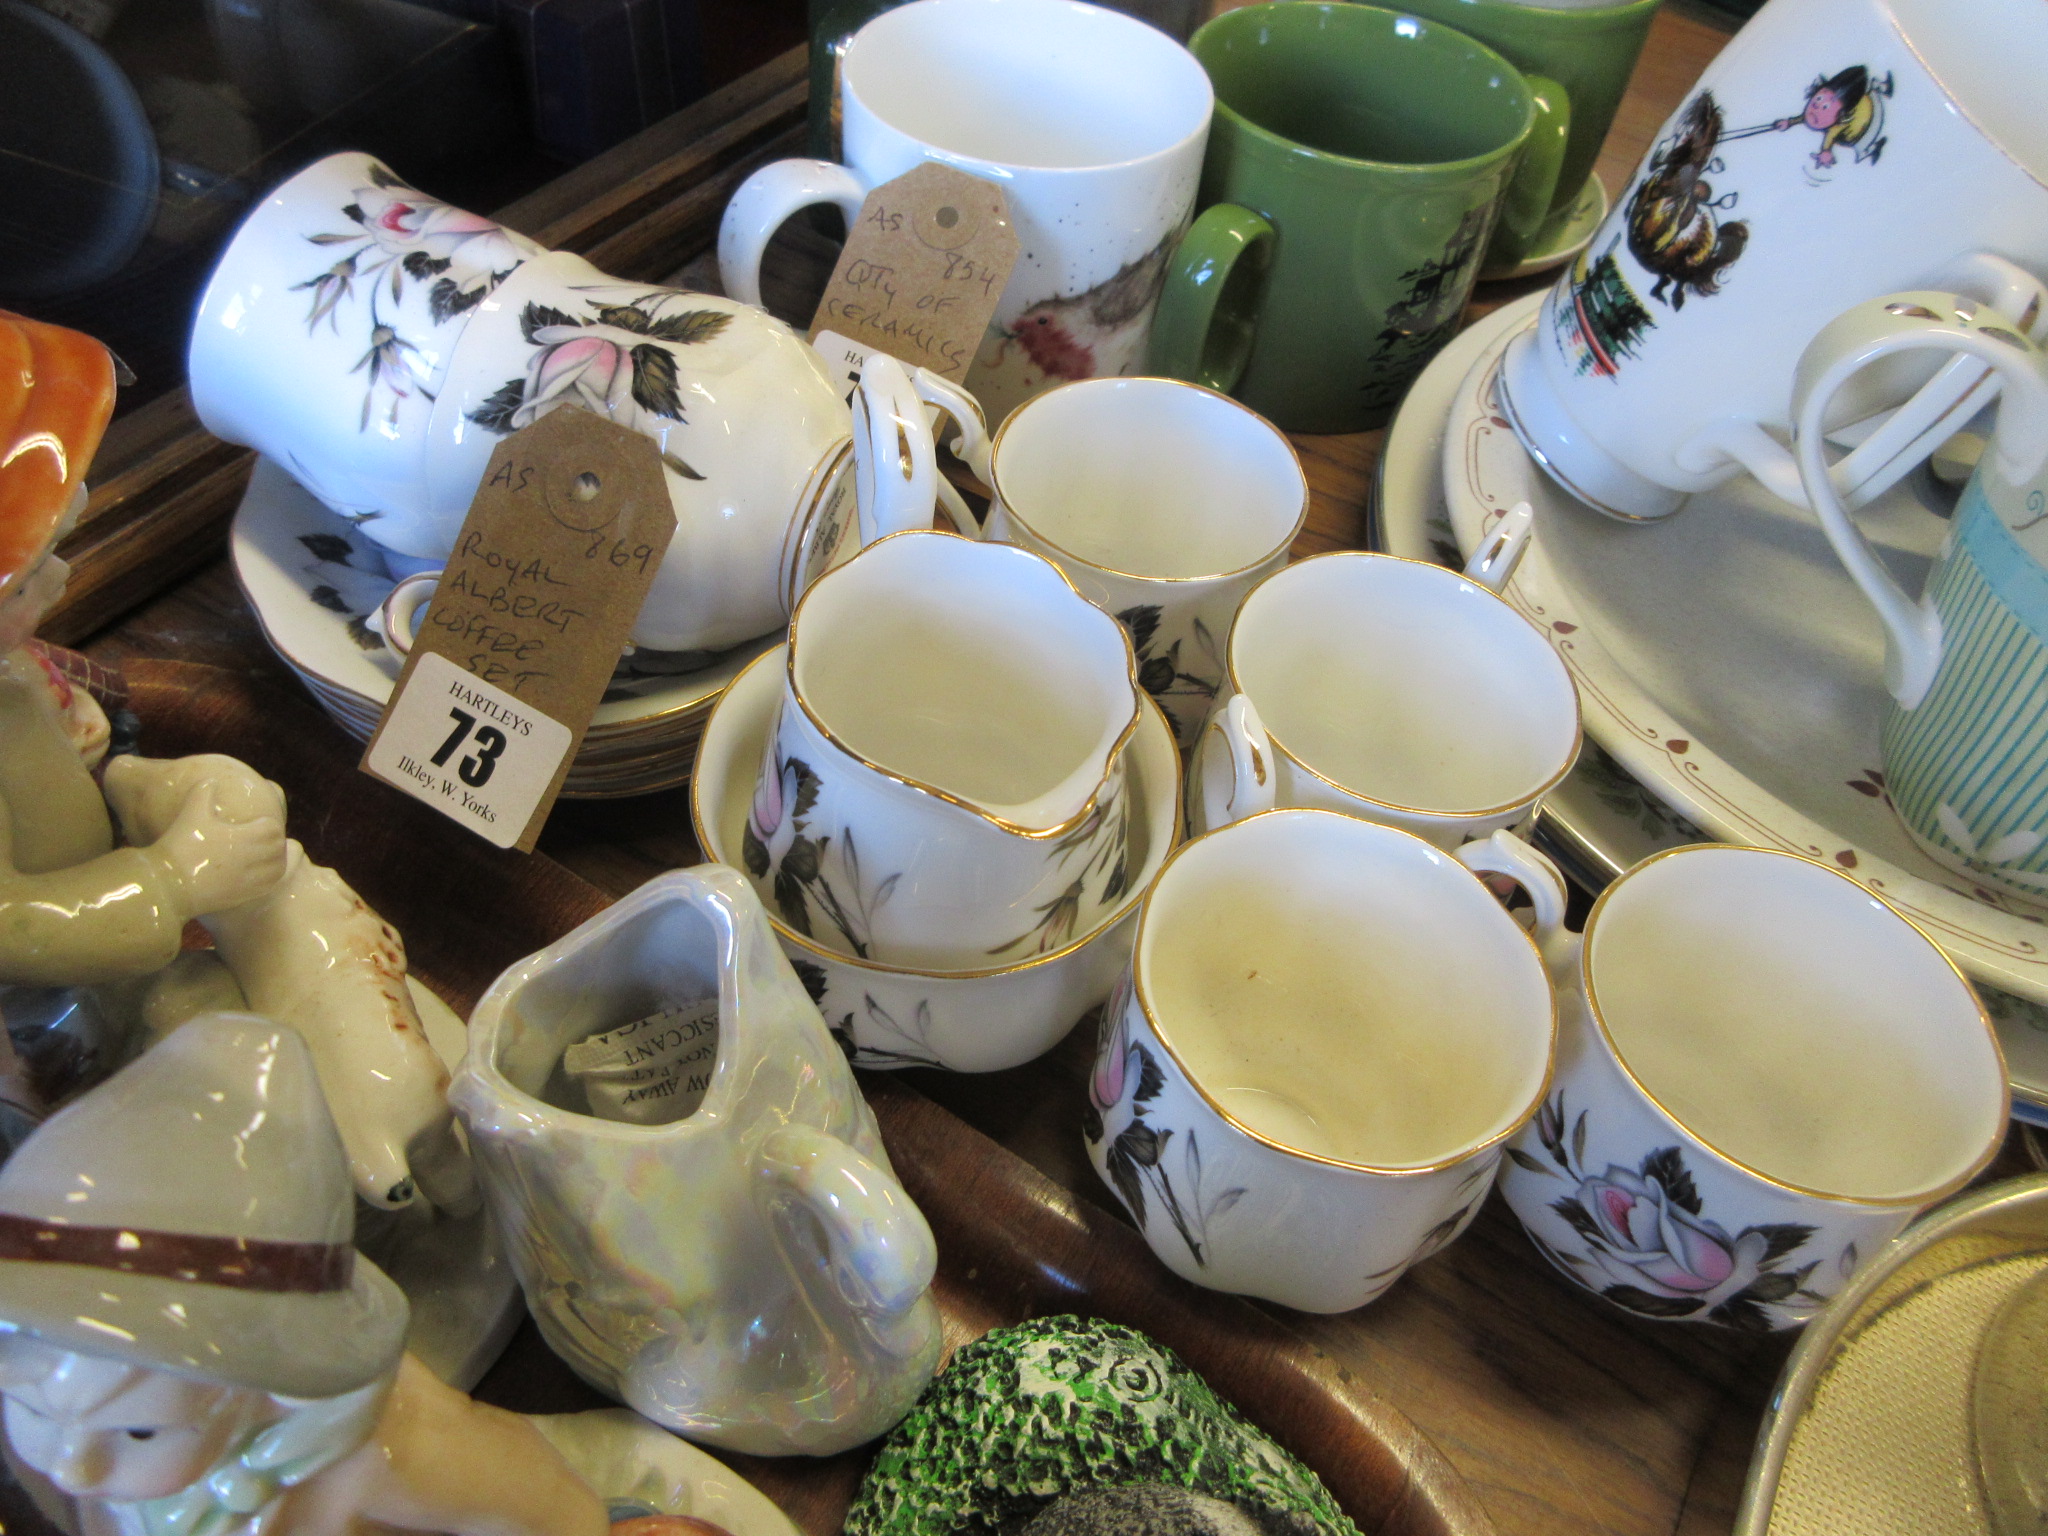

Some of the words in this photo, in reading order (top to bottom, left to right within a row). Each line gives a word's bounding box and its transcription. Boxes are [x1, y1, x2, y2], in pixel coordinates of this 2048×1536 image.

[867, 206, 903, 232] AS
[943, 252, 996, 297] 854
[916, 295, 960, 313] OF
[490, 460, 534, 492] AS
[461, 531, 569, 586] ROYAL
[584, 526, 654, 574] 869
[449, 570, 584, 633] ALBERT
[433, 606, 544, 661] COFFEE
[467, 654, 550, 691] SET
[448, 681, 533, 738] HARTLEYS
[430, 706, 507, 788] 73
[397, 754, 438, 791] Ilkley,
[440, 775, 460, 801] W.
[459, 792, 497, 824] Yorks
